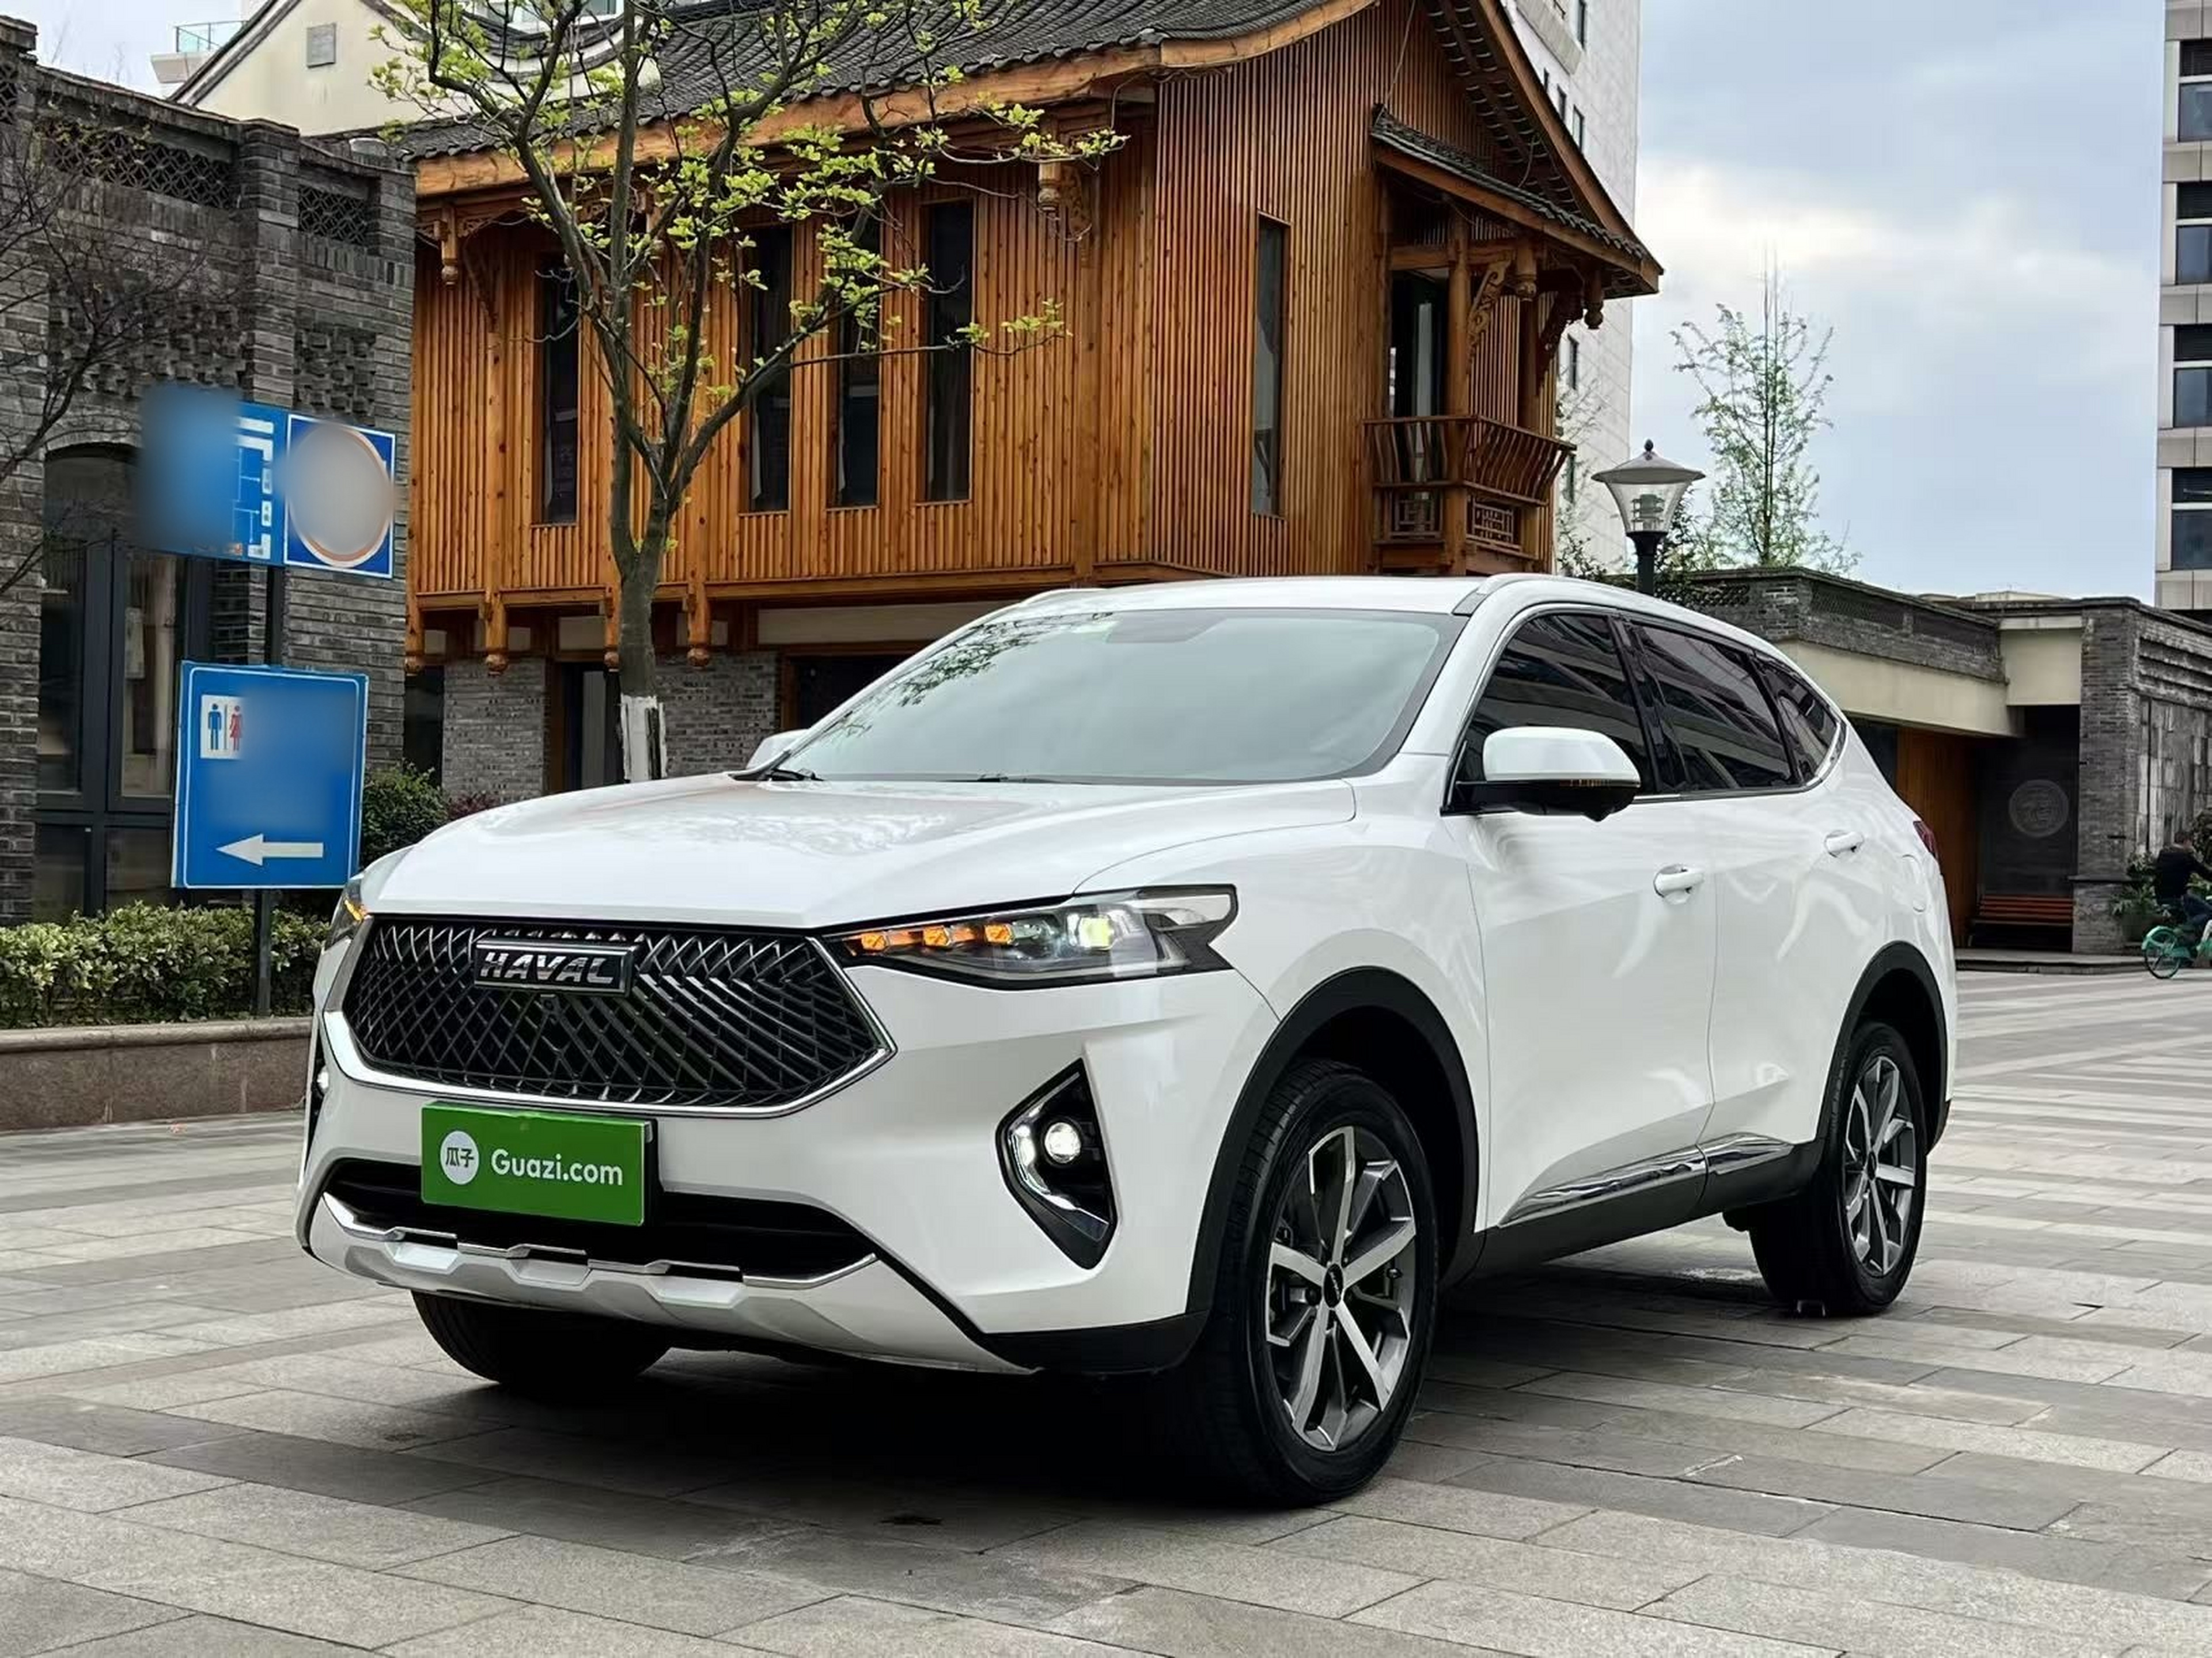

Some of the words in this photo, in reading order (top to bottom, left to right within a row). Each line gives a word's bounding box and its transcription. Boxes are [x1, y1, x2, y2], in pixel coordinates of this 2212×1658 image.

[480, 951, 615, 985] HAVAL
[445, 1147, 475, 1168] 瓜子
[491, 1148, 623, 1186] Guazi.com
